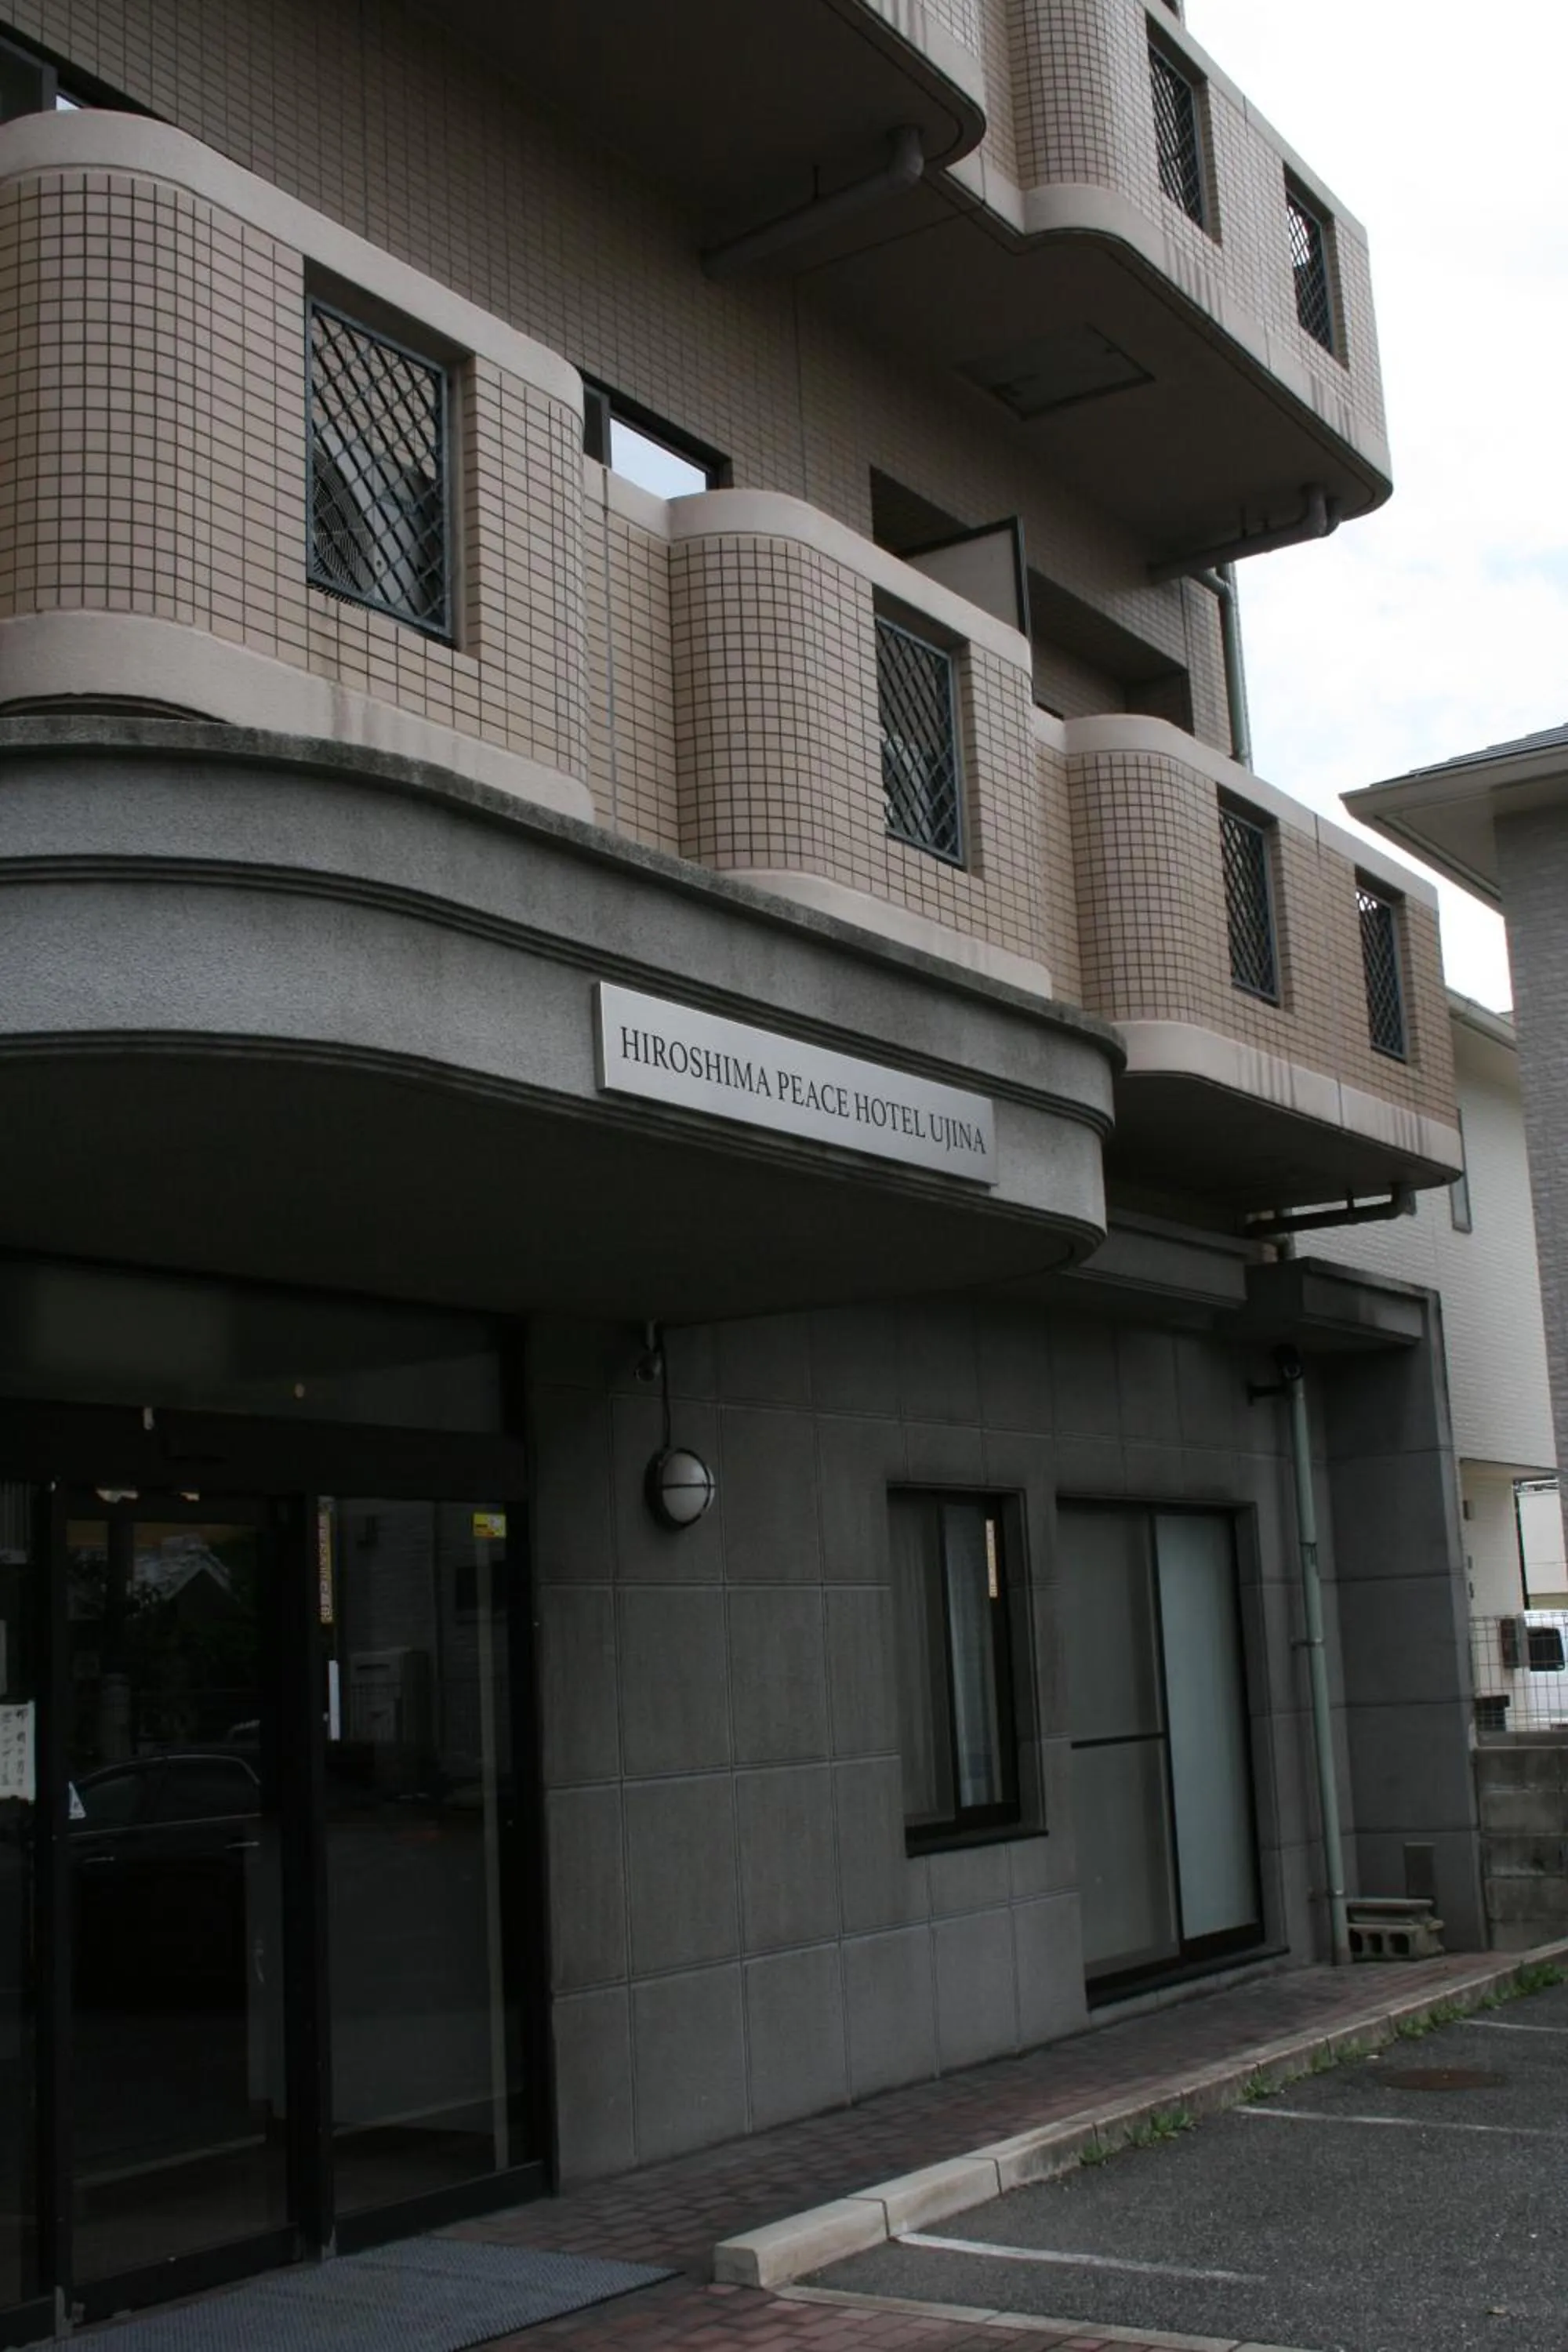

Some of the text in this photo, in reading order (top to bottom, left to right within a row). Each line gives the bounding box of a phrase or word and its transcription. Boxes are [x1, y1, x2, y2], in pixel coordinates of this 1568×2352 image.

[620, 1027, 986, 1154] HIROSHIMA PEACE HOTEL UJINA
